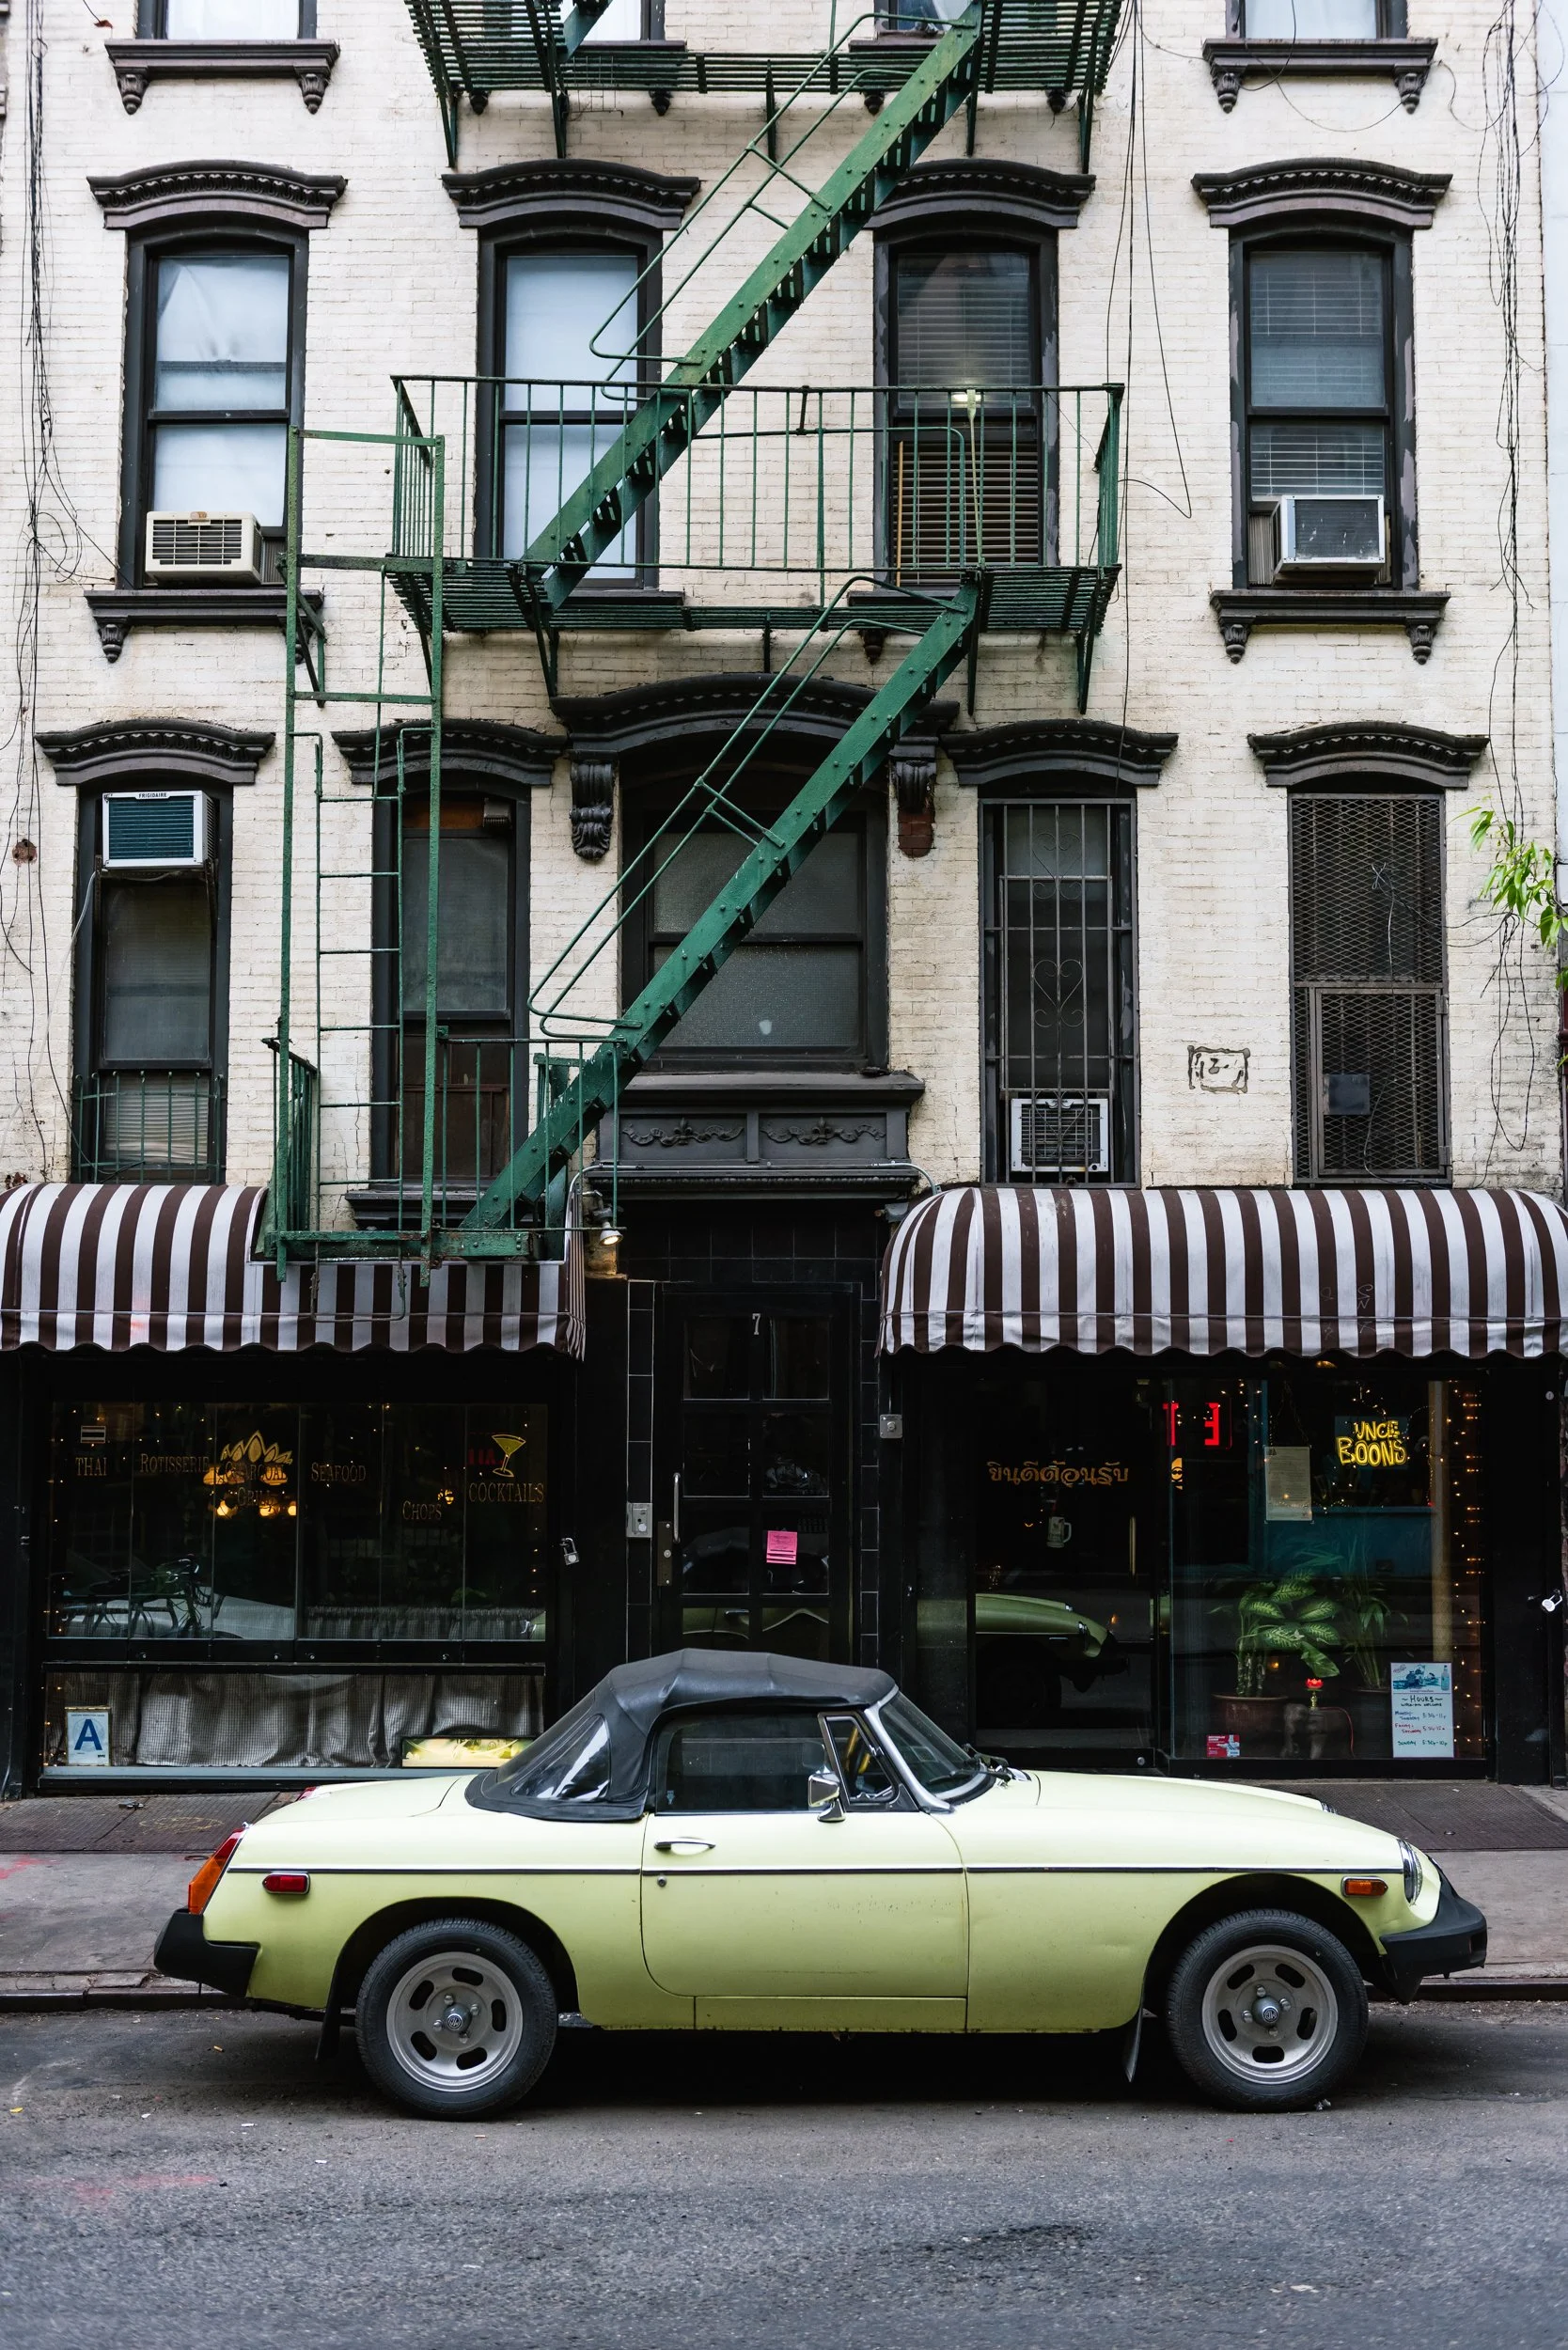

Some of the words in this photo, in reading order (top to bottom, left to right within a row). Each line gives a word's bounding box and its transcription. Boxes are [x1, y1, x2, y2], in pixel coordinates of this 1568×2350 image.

[752, 1312, 761, 1335] 7
[1354, 1419, 1400, 1440] UNCLE
[1336, 1435, 1407, 1466] BOONS
[75, 1457, 107, 1476] THAI
[140, 1453, 210, 1473] ROTISSERIE
[225, 1461, 288, 1481] CRCOAL
[311, 1462, 367, 1482] SEAFOOD
[469, 1482, 544, 1503] COCKTAILS
[402, 1500, 442, 1520] CHOPS
[74, 1718, 103, 1751] A
